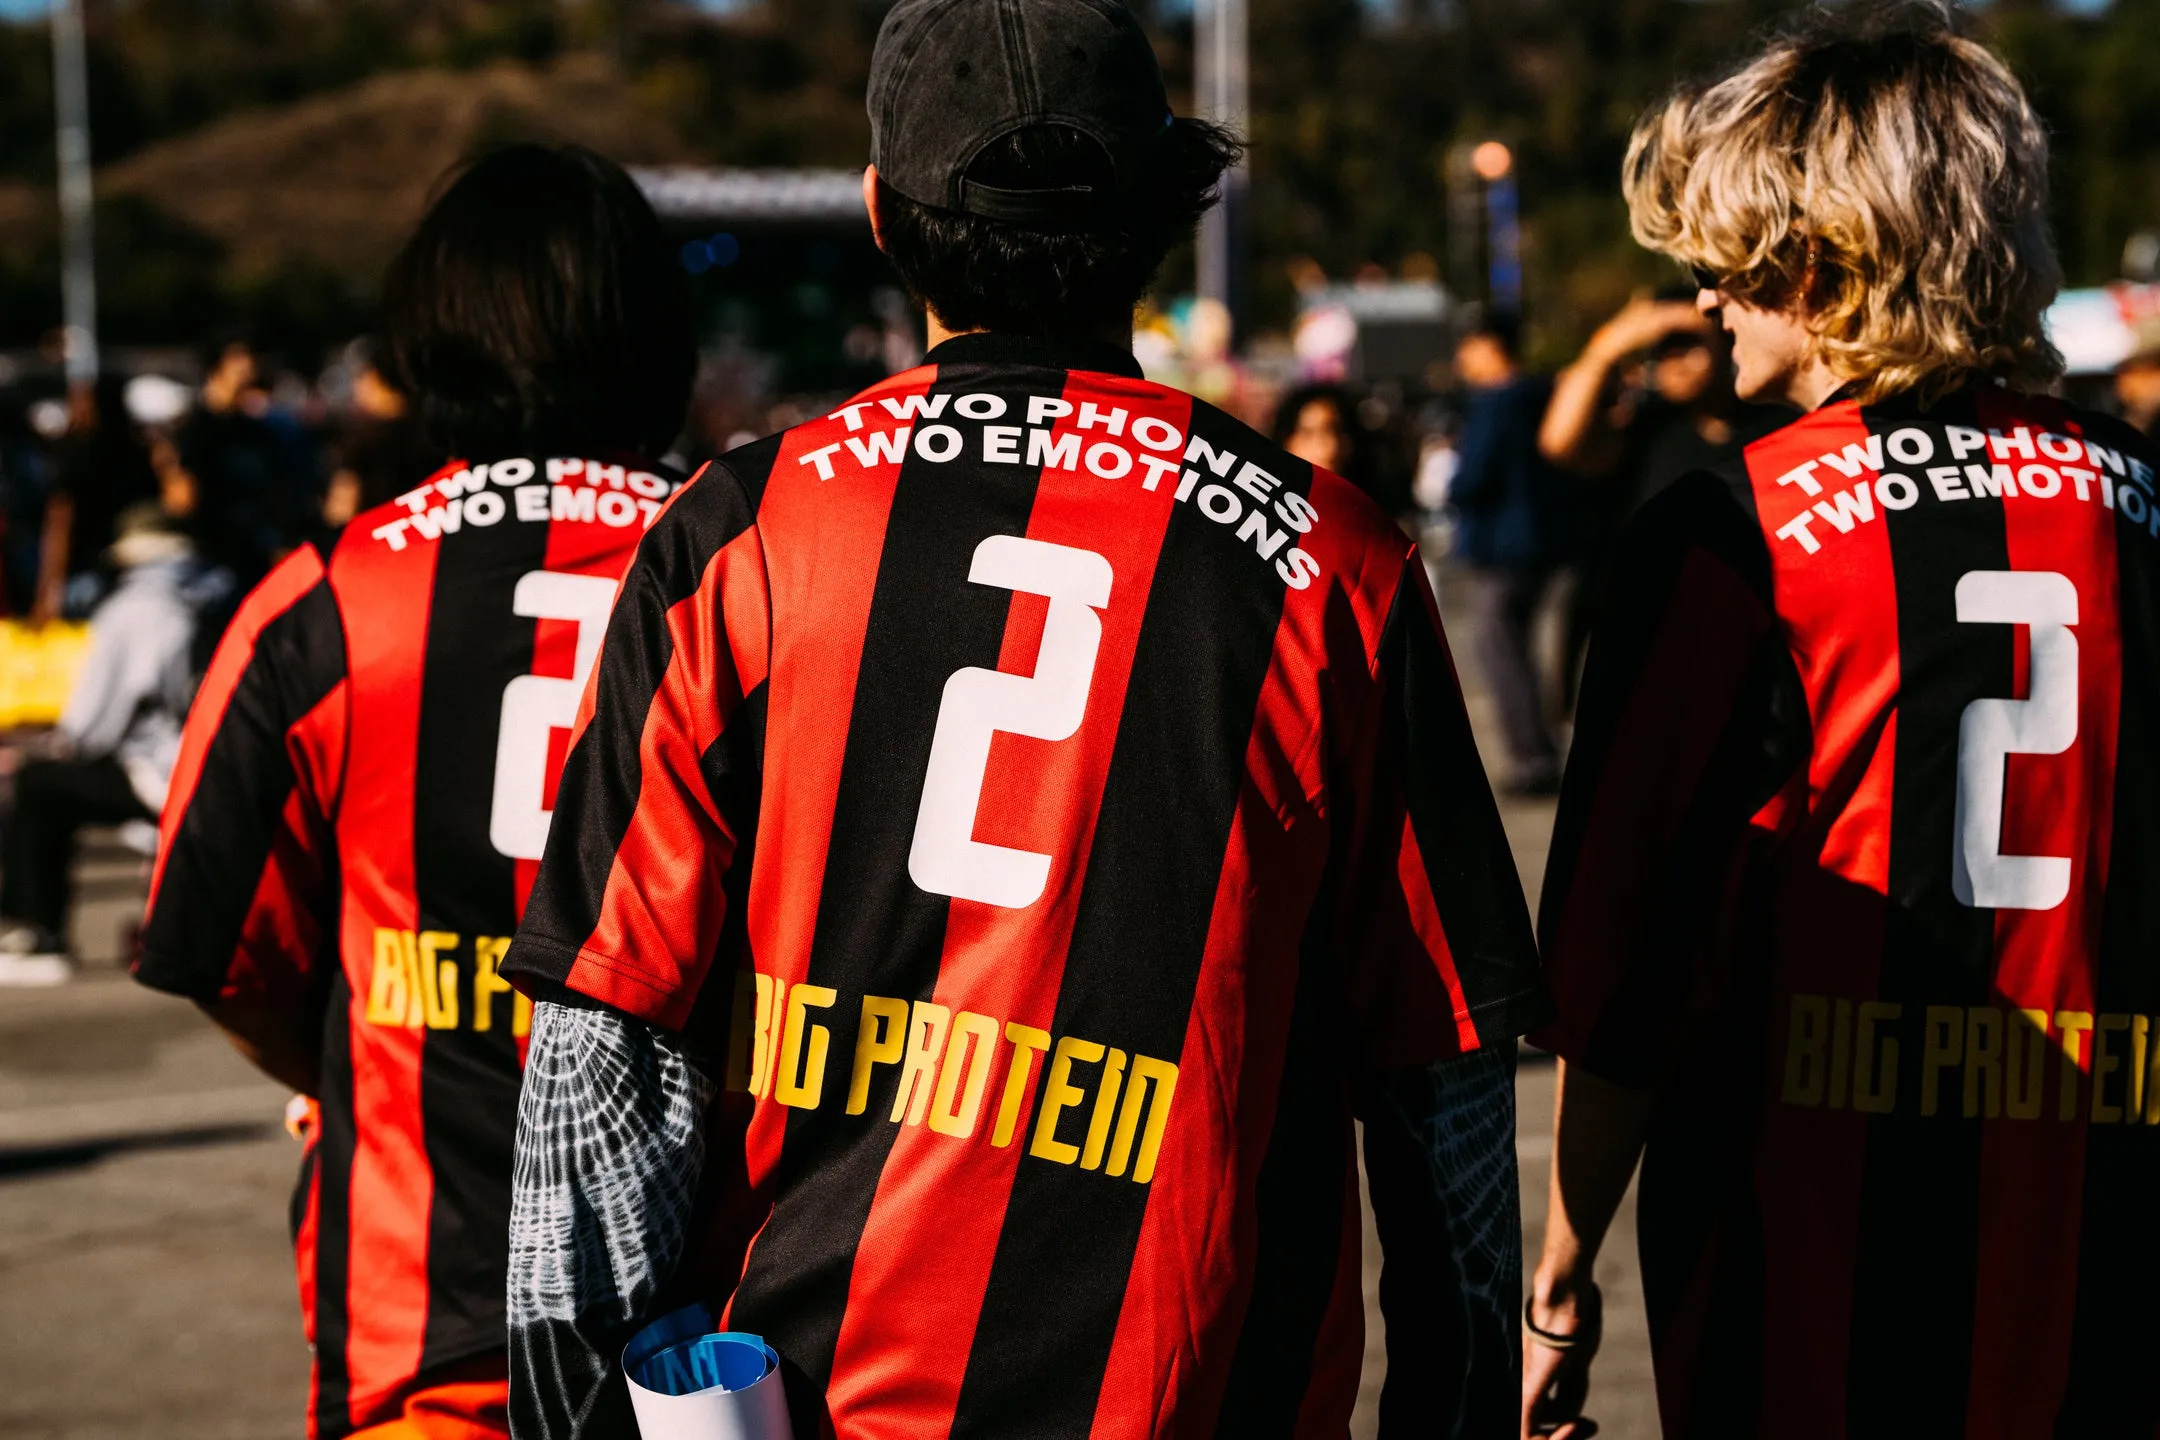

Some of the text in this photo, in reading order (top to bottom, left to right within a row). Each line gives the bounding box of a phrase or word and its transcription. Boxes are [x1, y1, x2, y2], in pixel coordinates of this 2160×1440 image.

[371, 490, 507, 553] TWO
[394, 456, 684, 514] TWO PHO
[797, 424, 1321, 591] TWO EMOTIONS
[827, 392, 1320, 535] TWO PHONES
[1774, 472, 1920, 556] TWO
[1775, 426, 1935, 498] TWO
[489, 569, 621, 862] 2
[907, 534, 1115, 910] 2
[1951, 569, 2080, 912] 2
[366, 926, 462, 1032] BIG
[724, 970, 1180, 1185] BIG PROTEIN
[1779, 992, 1904, 1115] BIG
